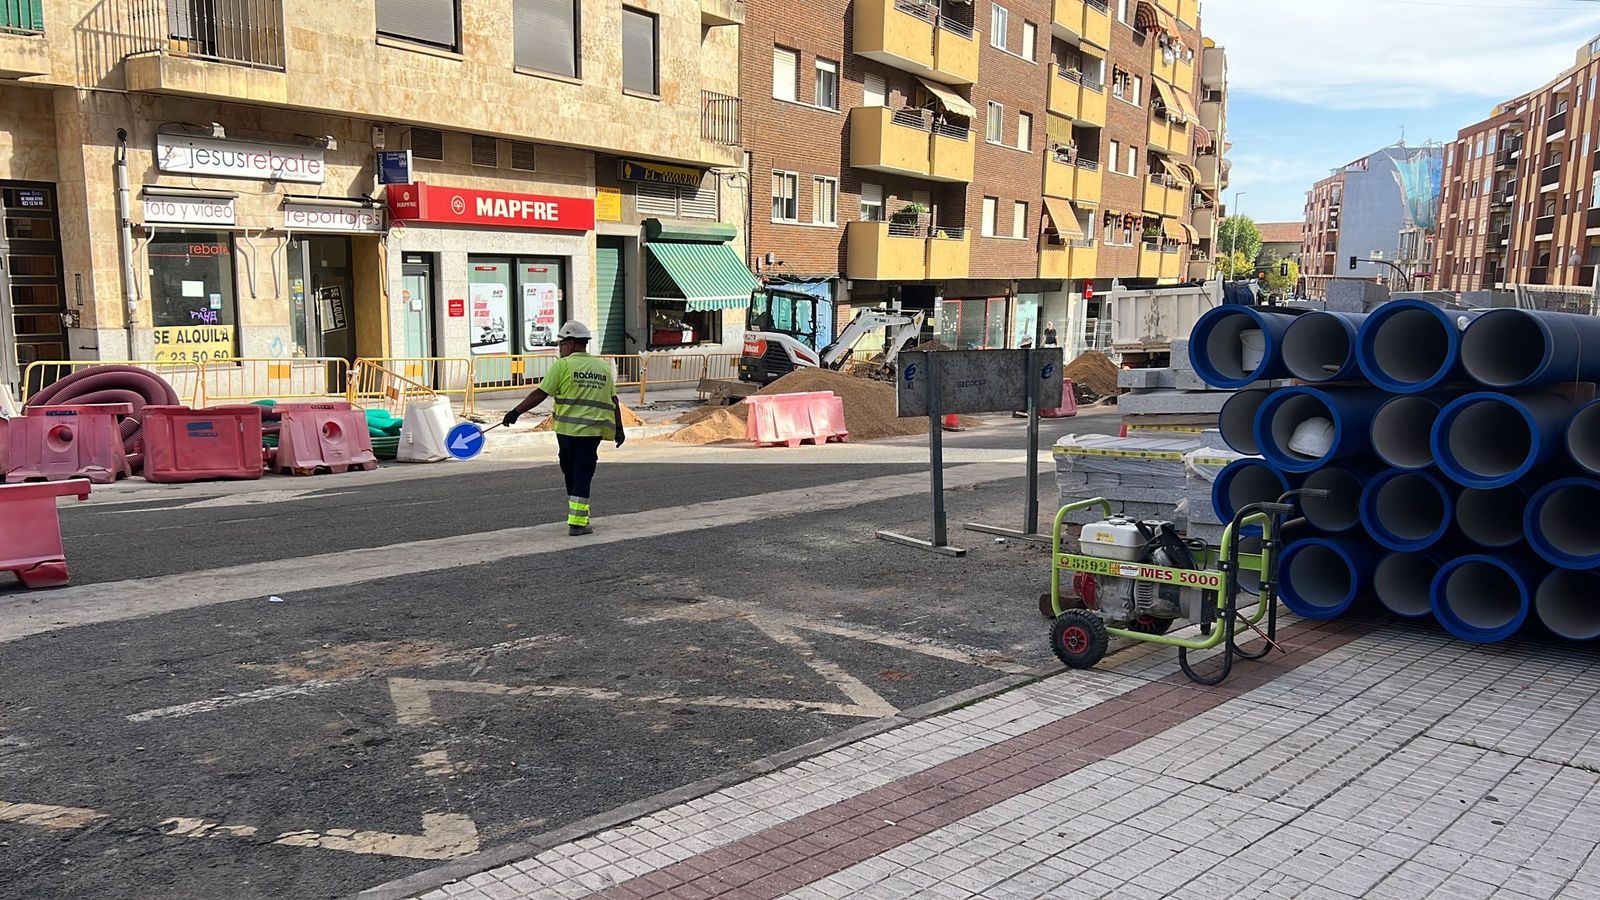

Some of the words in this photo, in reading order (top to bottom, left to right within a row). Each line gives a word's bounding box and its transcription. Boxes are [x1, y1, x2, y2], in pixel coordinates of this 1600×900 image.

[145, 198, 176, 218] foto
[181, 205, 189, 220] y
[476, 196, 559, 221] MAPFRE
[286, 209, 381, 230] reportajes
[154, 329, 170, 344] SE
[176, 329, 230, 344] ALQUILA
[192, 351, 209, 363] 50
[573, 370, 607, 382] ROCÁVILA
[1071, 557, 1108, 573] 5592
[1140, 567, 1173, 581] MES
[1179, 571, 1219, 587] 5000
